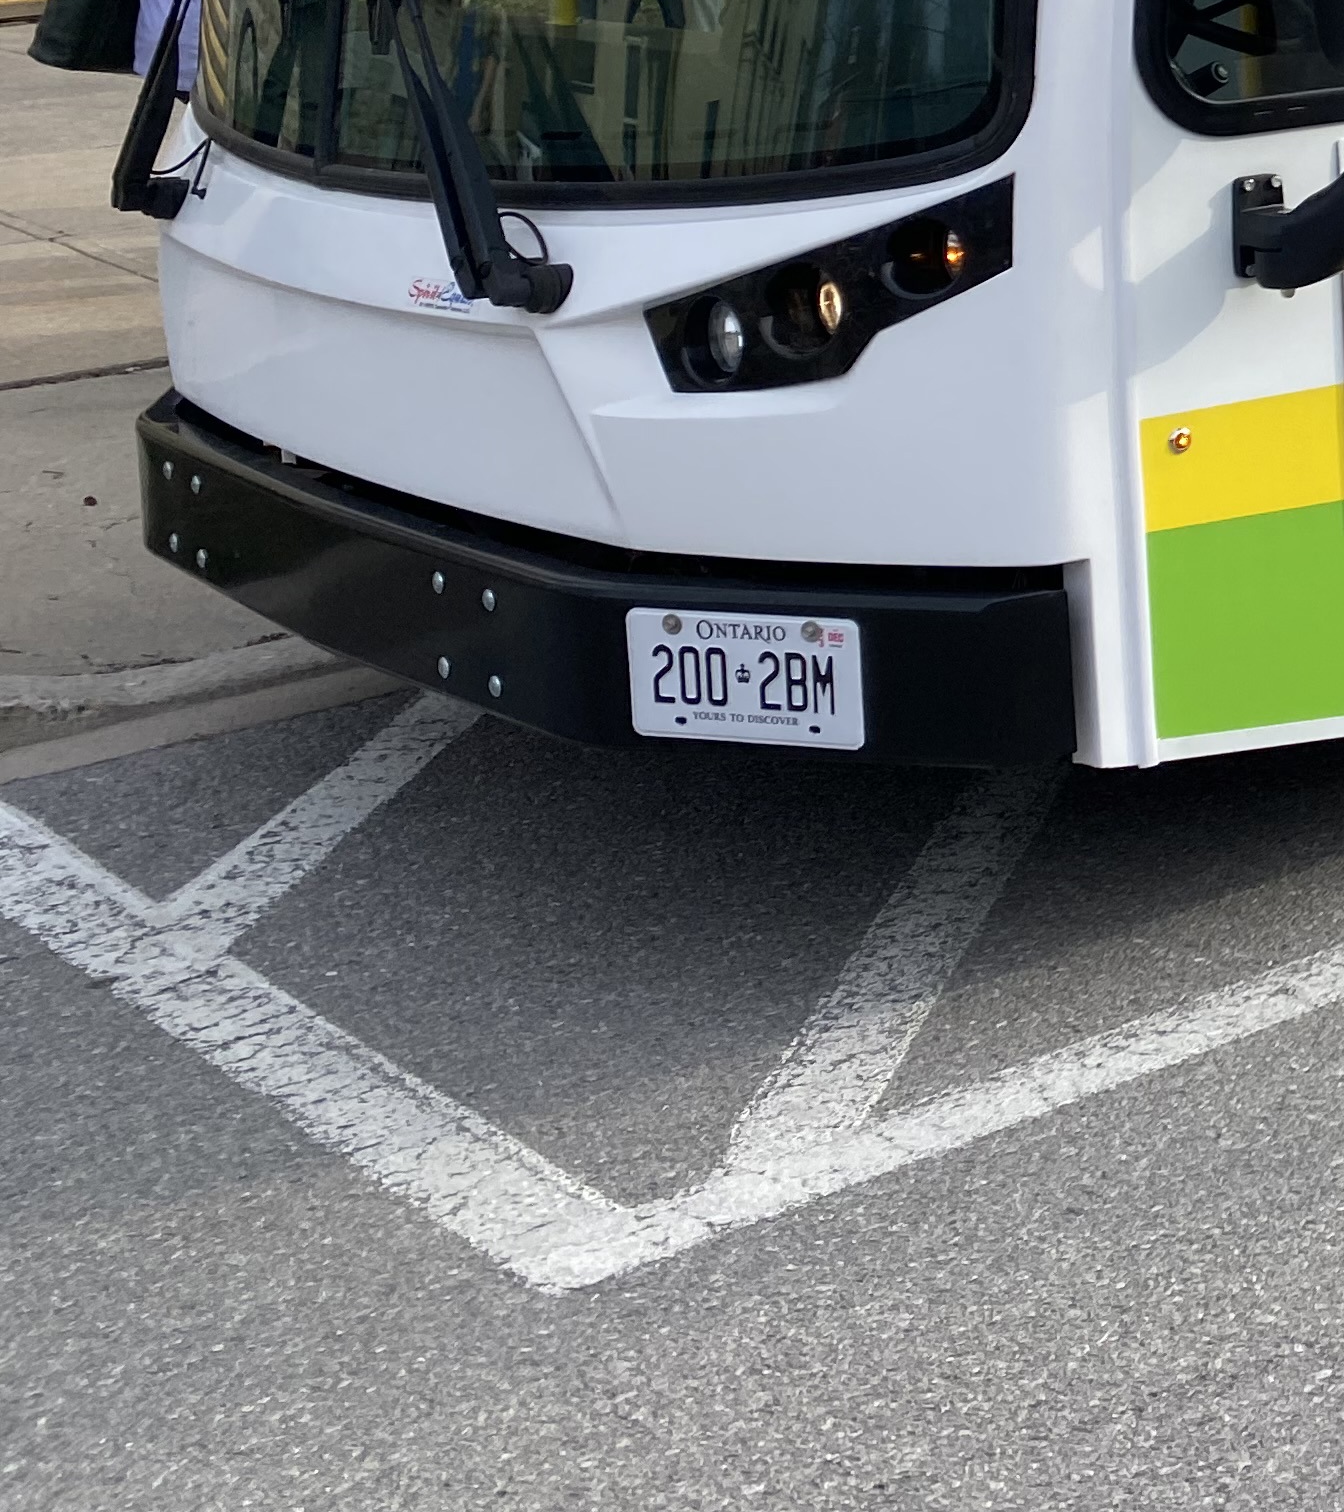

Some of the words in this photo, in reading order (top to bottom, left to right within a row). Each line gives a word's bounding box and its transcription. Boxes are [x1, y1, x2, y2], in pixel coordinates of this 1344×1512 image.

[695, 619, 787, 644] ONTARIO
[692, 711, 726, 723] YOURS
[729, 713, 745, 723] TO
[747, 714, 799, 727] DISCOVER
